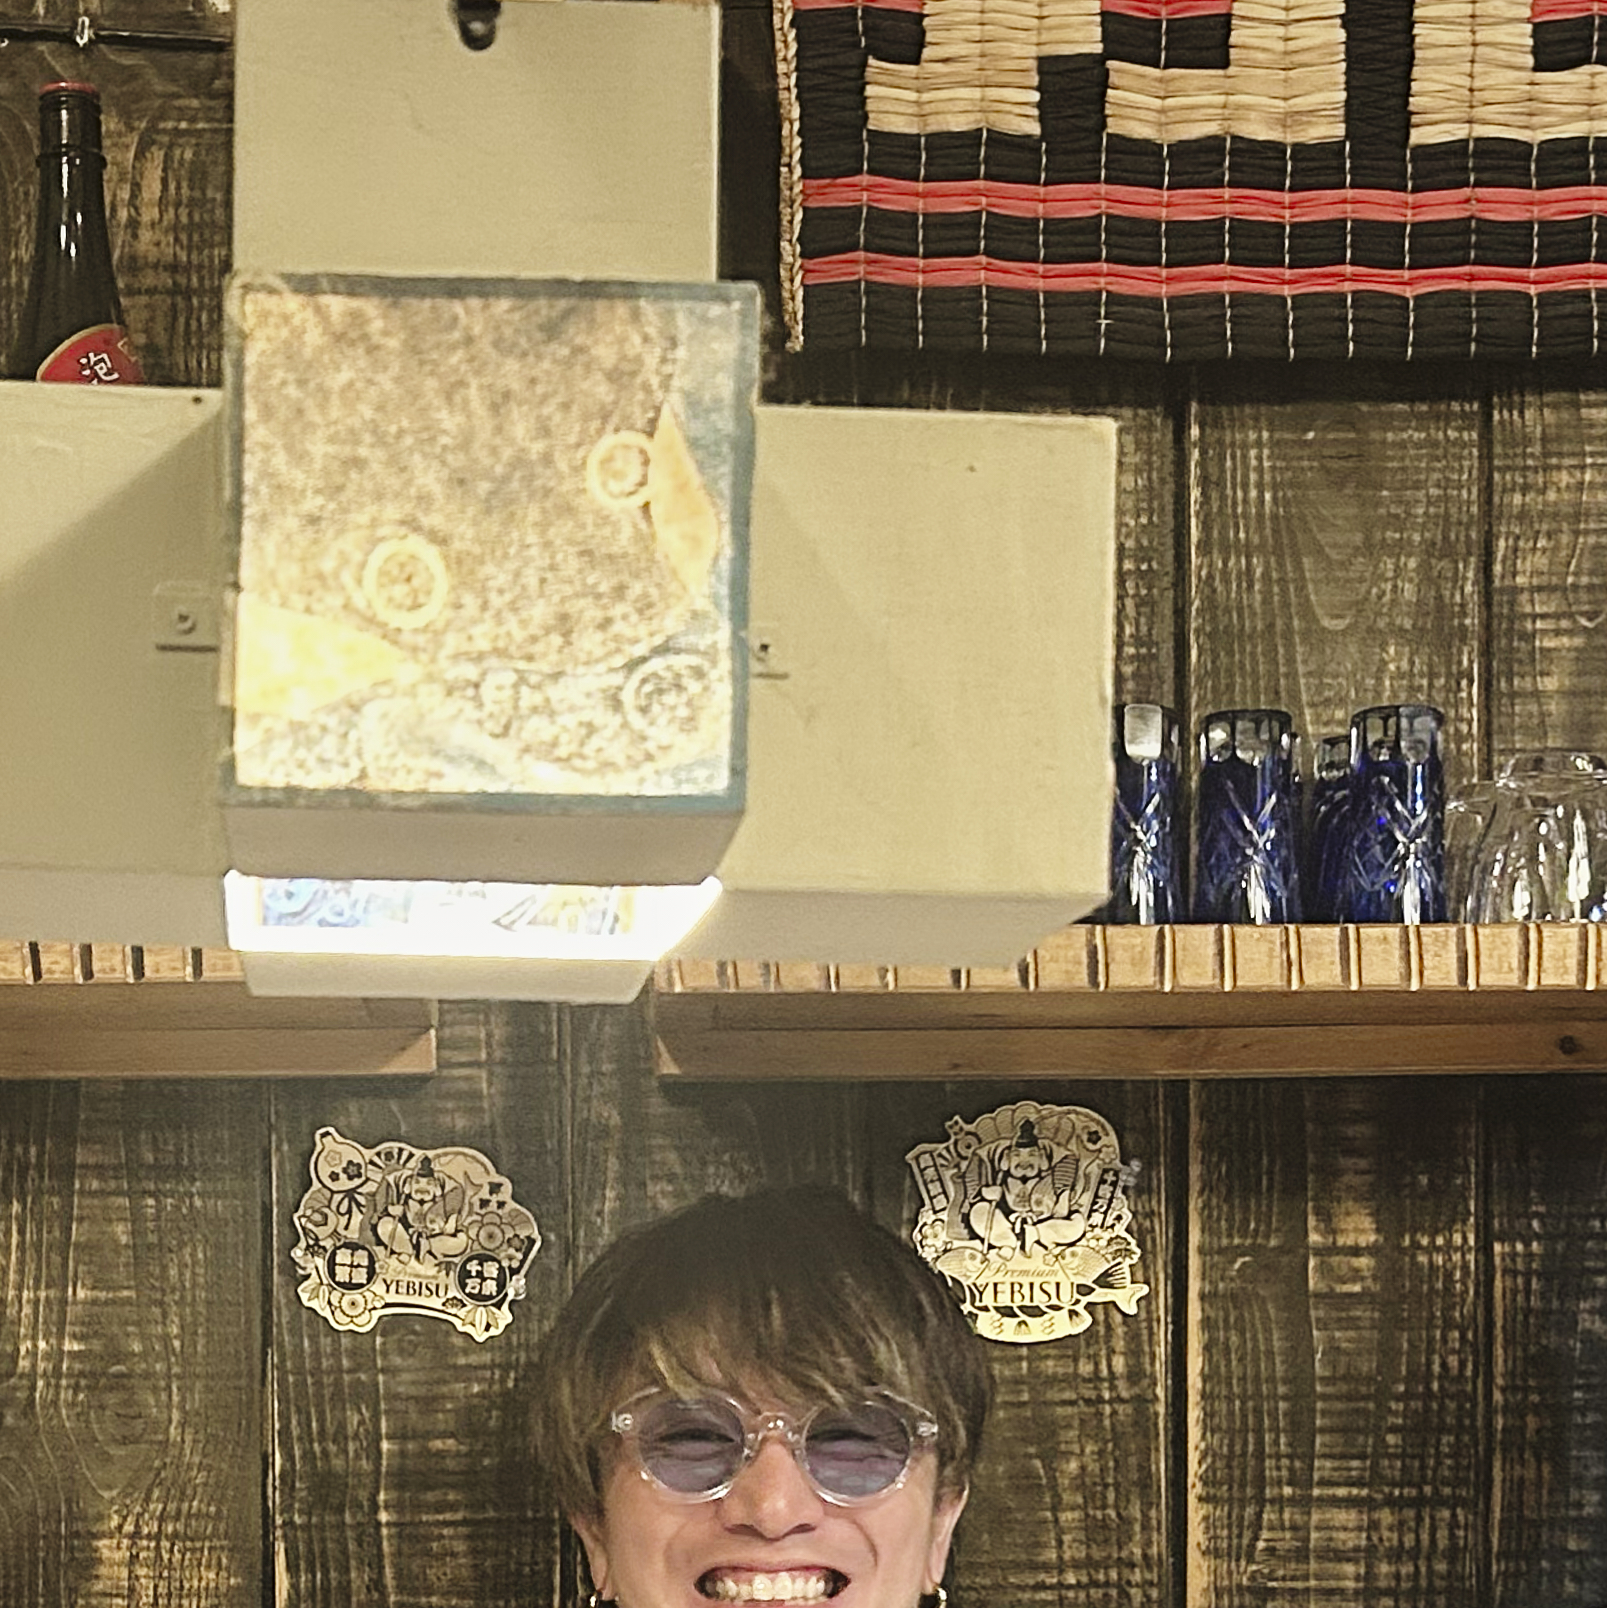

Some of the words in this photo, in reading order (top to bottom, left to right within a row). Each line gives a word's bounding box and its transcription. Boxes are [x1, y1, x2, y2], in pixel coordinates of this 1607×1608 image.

[986, 1261, 1060, 1279] Premium
[382, 1277, 449, 1299] YEBISU
[973, 1281, 1075, 1304] YEBISU
